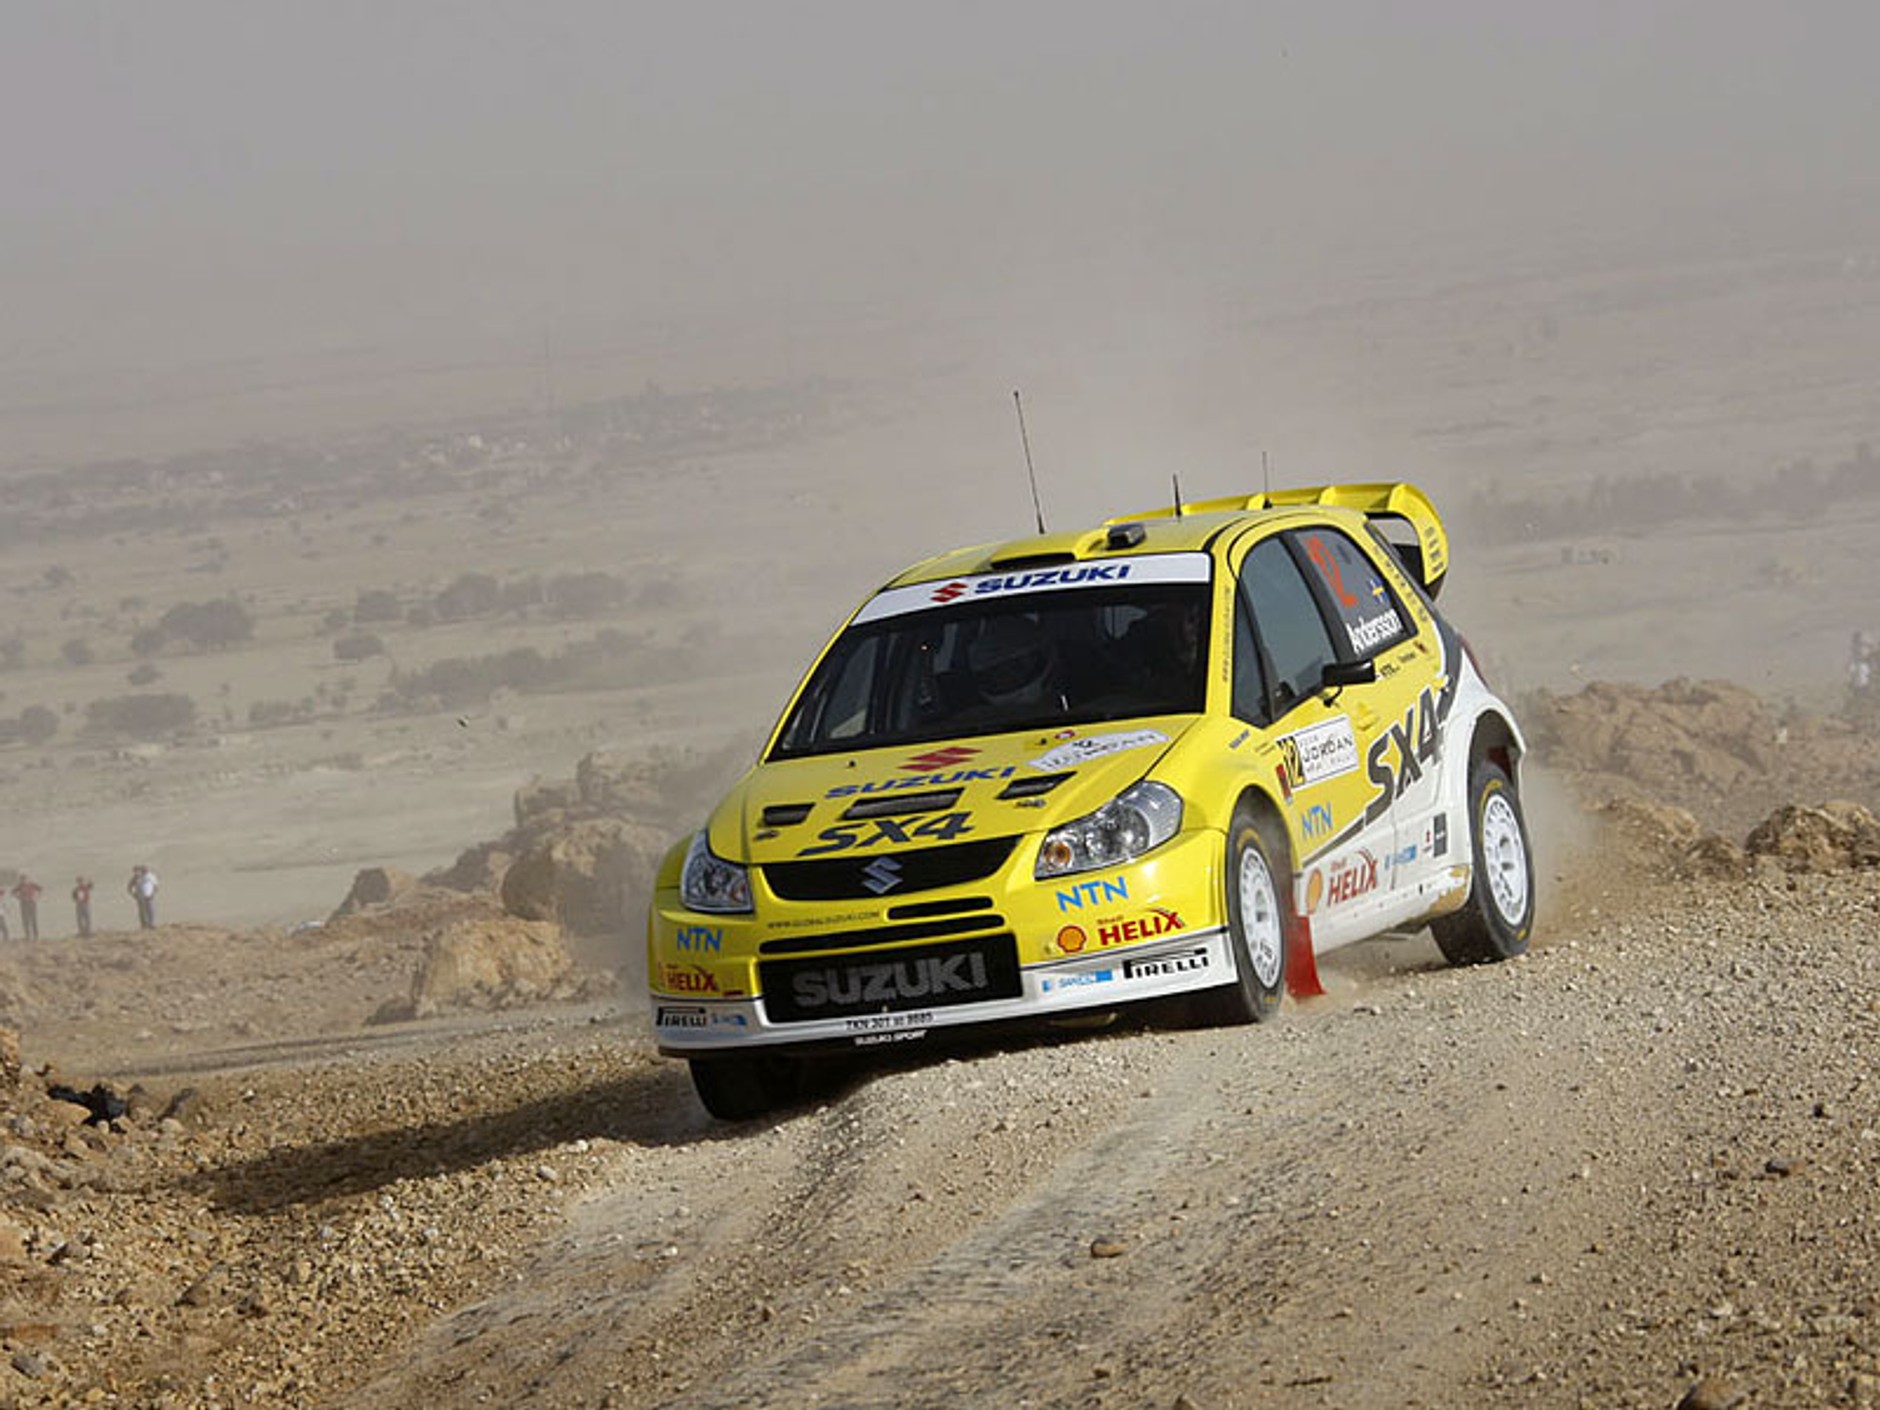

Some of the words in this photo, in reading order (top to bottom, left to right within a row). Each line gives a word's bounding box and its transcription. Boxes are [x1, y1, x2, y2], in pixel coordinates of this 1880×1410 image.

[974, 565, 1130, 595] SUZUKI
[1366, 685, 1444, 828] SX4
[825, 766, 1016, 798] SUZUKI
[796, 811, 974, 857] SX4
[1302, 803, 1332, 841] NTN
[1056, 876, 1129, 912] NTN
[1327, 857, 1378, 907] HELIX
[677, 928, 723, 952] NTN
[1099, 910, 1183, 945] HELIX
[667, 969, 722, 992] HELIX
[791, 952, 989, 1006] SUZUKI
[1123, 947, 1209, 980] PIRELLI
[656, 1005, 709, 1027] PIRELLI
